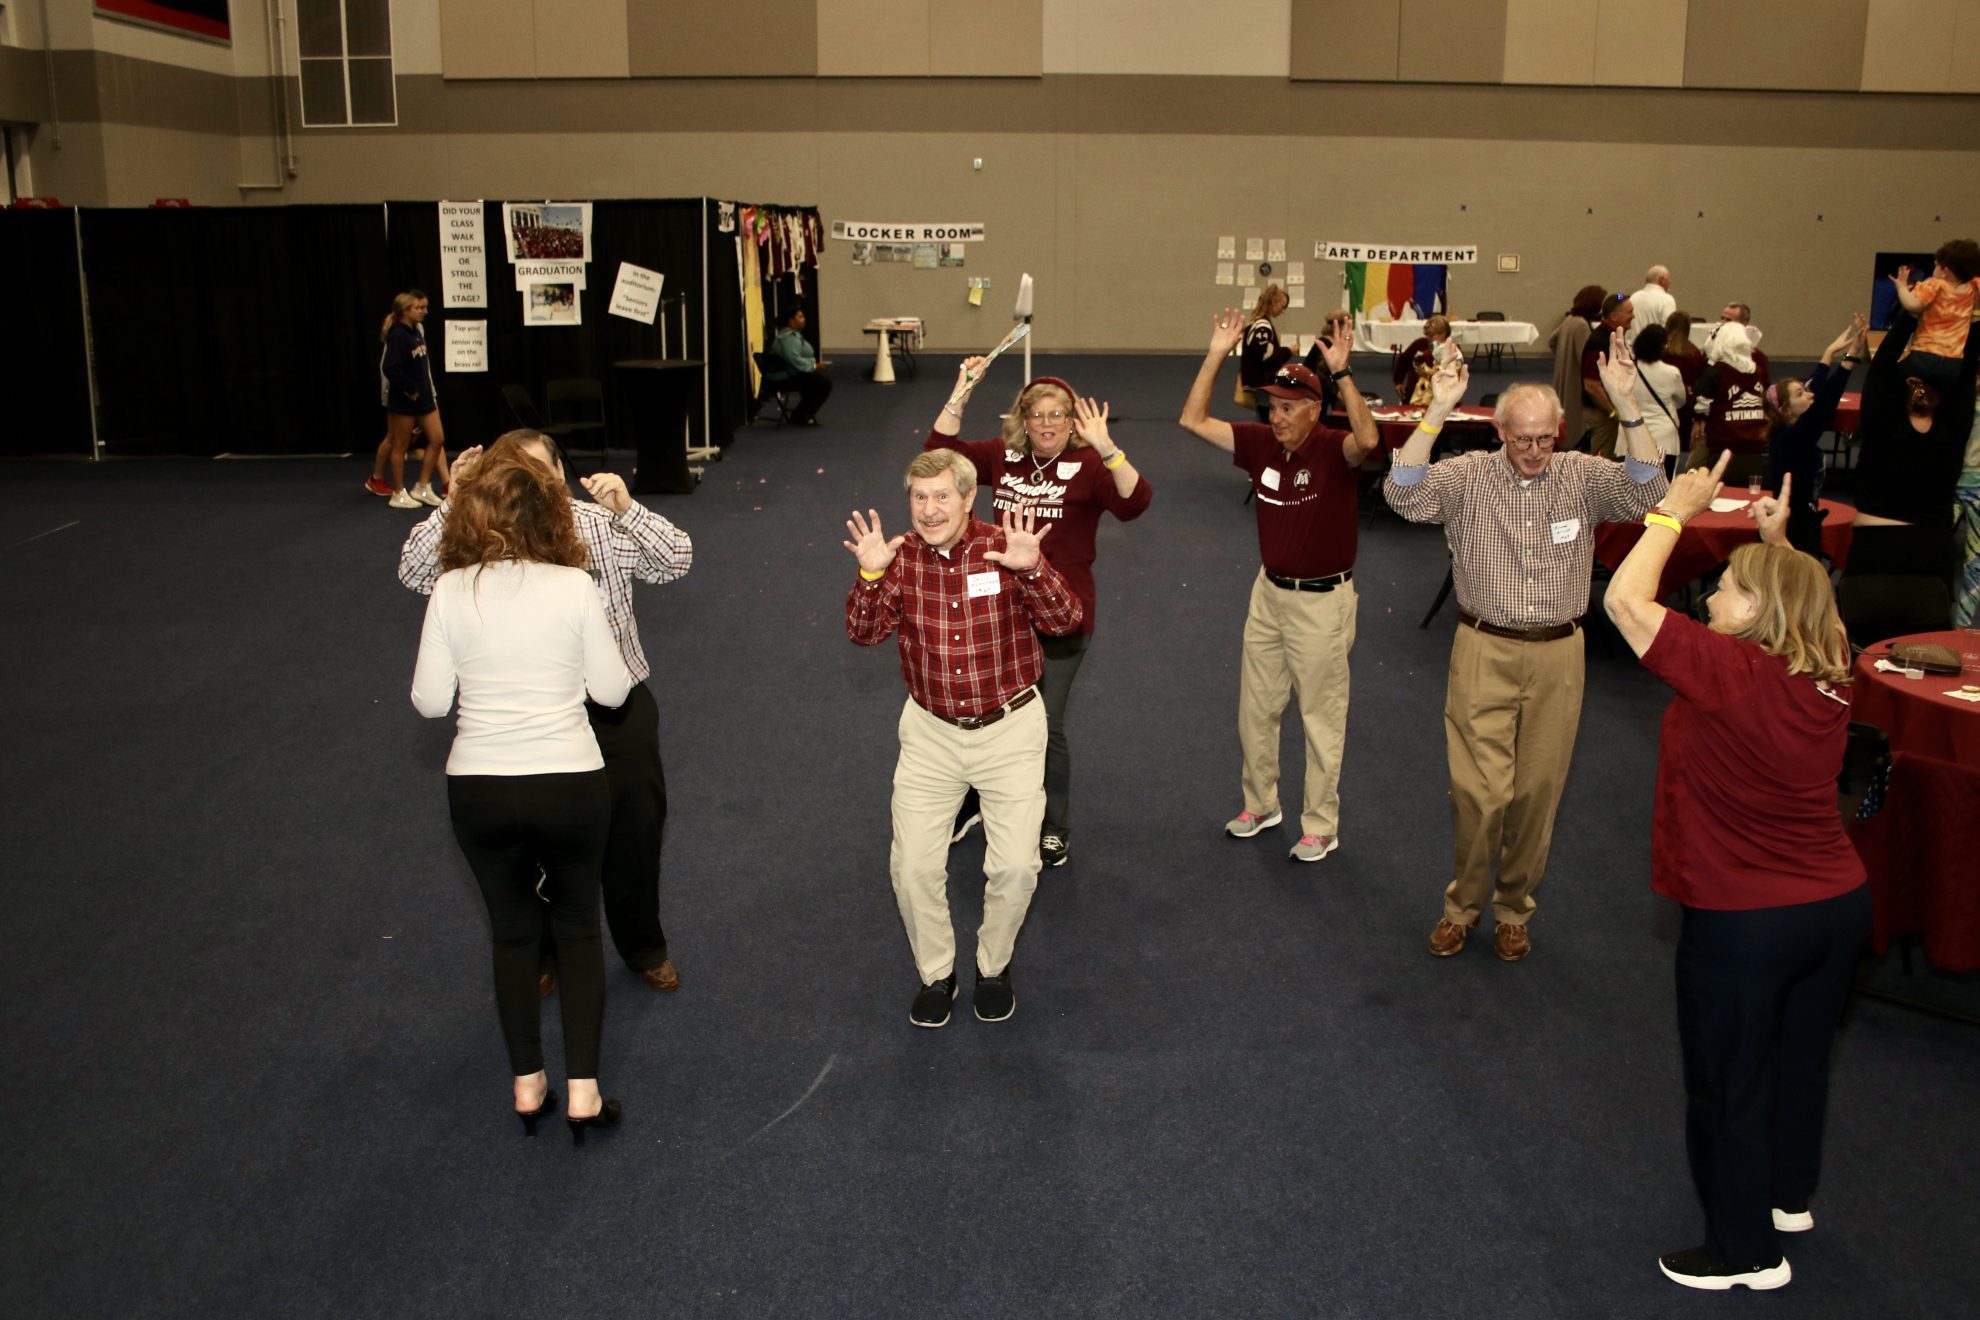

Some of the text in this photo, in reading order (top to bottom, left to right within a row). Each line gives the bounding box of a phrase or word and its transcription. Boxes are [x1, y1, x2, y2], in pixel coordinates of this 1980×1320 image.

[442, 207, 481, 215] DID YOUR
[450, 220, 474, 228] CLASS
[451, 233, 474, 241] WALK
[847, 227, 971, 239] LOCKER ROOM
[442, 245, 482, 253] THE STEPS
[1328, 247, 1475, 261] ART DEPARTMENT
[458, 257, 470, 265] OR
[451, 270, 478, 278] STROLL
[518, 266, 583, 276] GRADUATION
[458, 282, 472, 290] THE
[451, 295, 480, 303] STAGE?
[454, 324, 466, 333] Tap
[472, 338, 483, 347] ring
[1000, 472, 1067, 500] Handley
[1023, 506, 1063, 518] AUMNI
